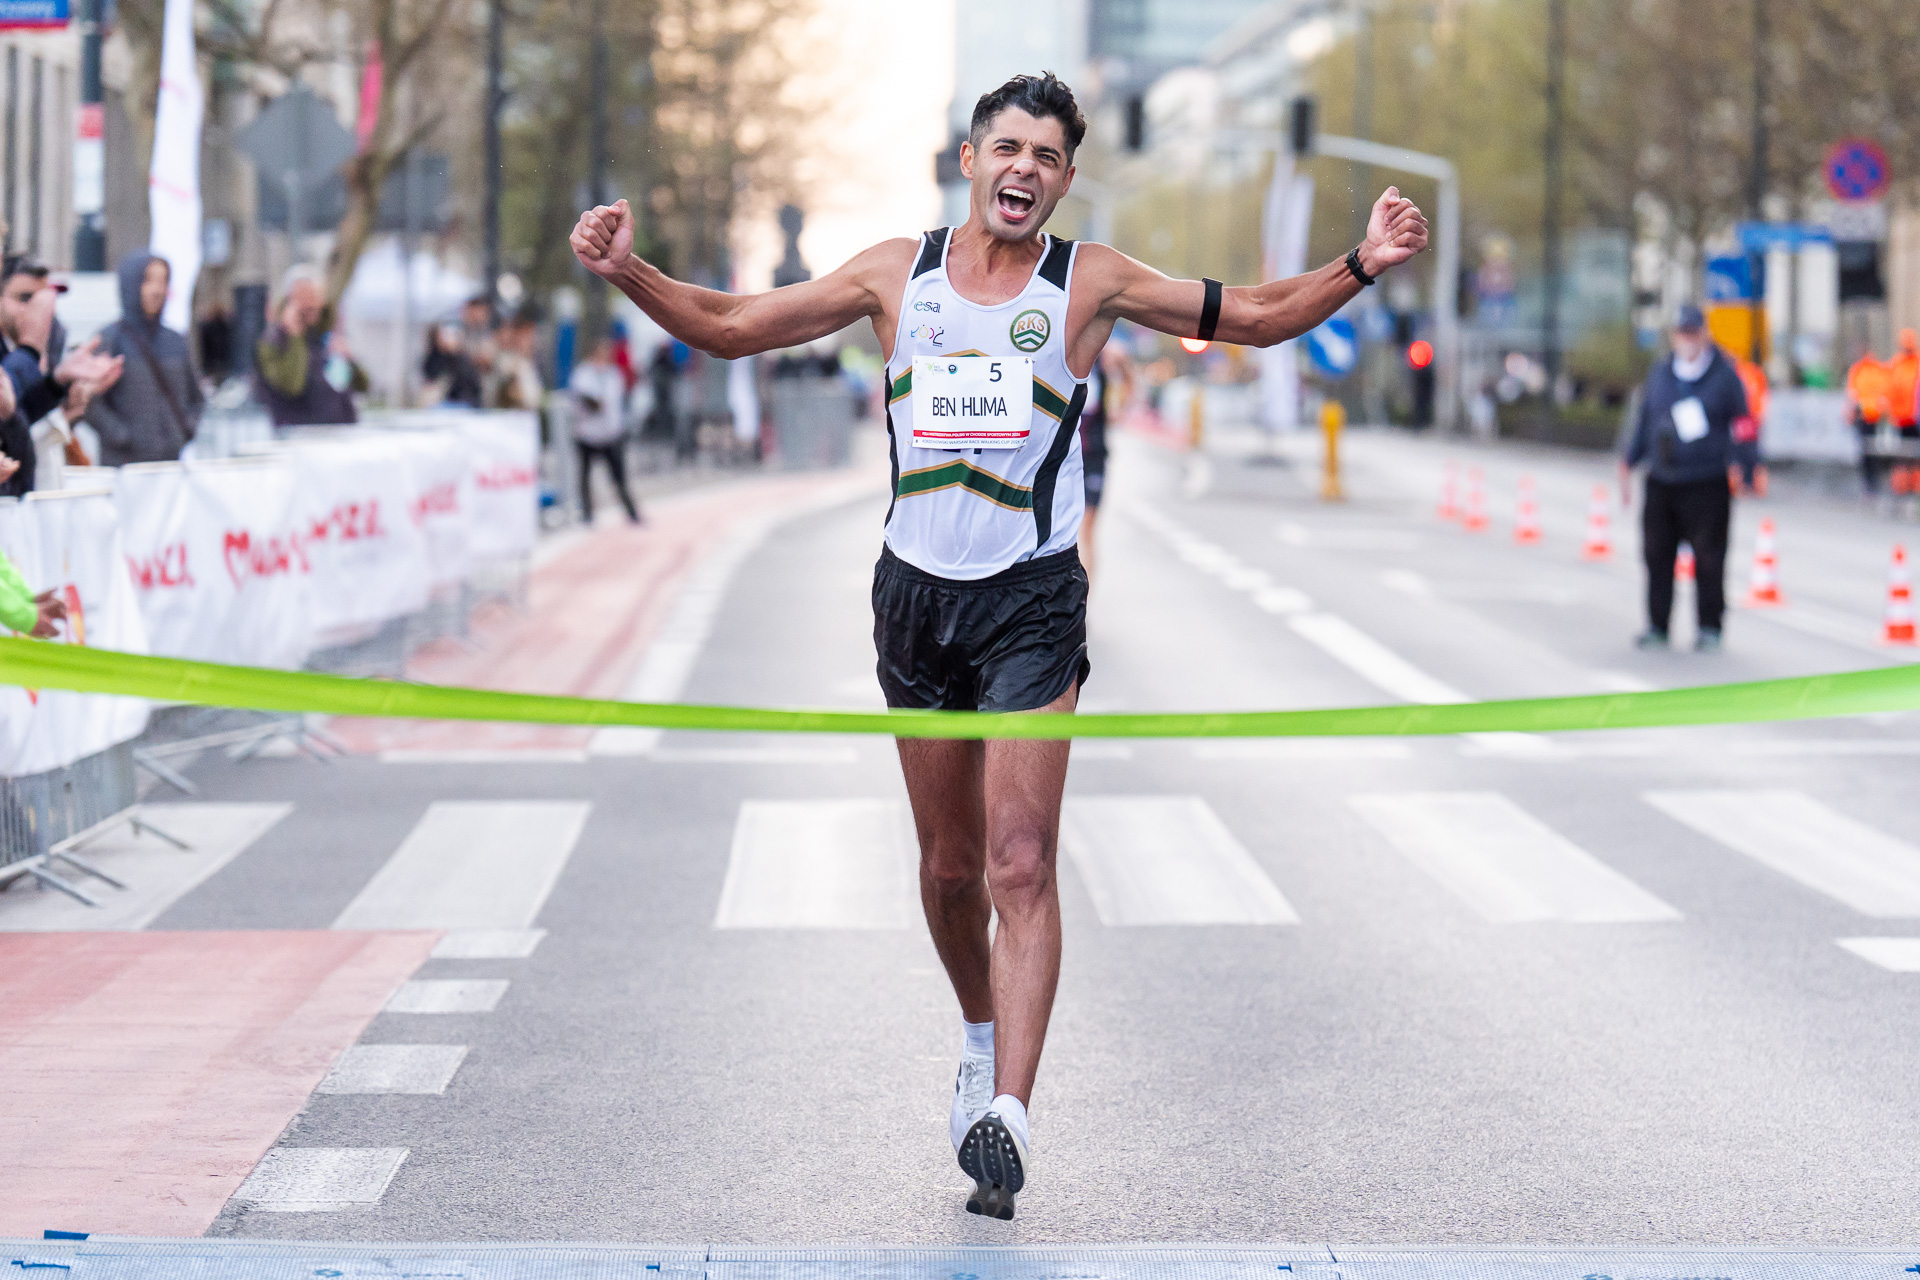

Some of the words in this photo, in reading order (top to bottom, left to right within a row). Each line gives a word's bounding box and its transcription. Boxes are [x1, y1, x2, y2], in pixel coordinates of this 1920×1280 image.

[1016, 315, 1046, 333] RKS
[989, 362, 1003, 383] 5
[932, 396, 956, 417] BEN
[962, 396, 1008, 417] HLIMA
